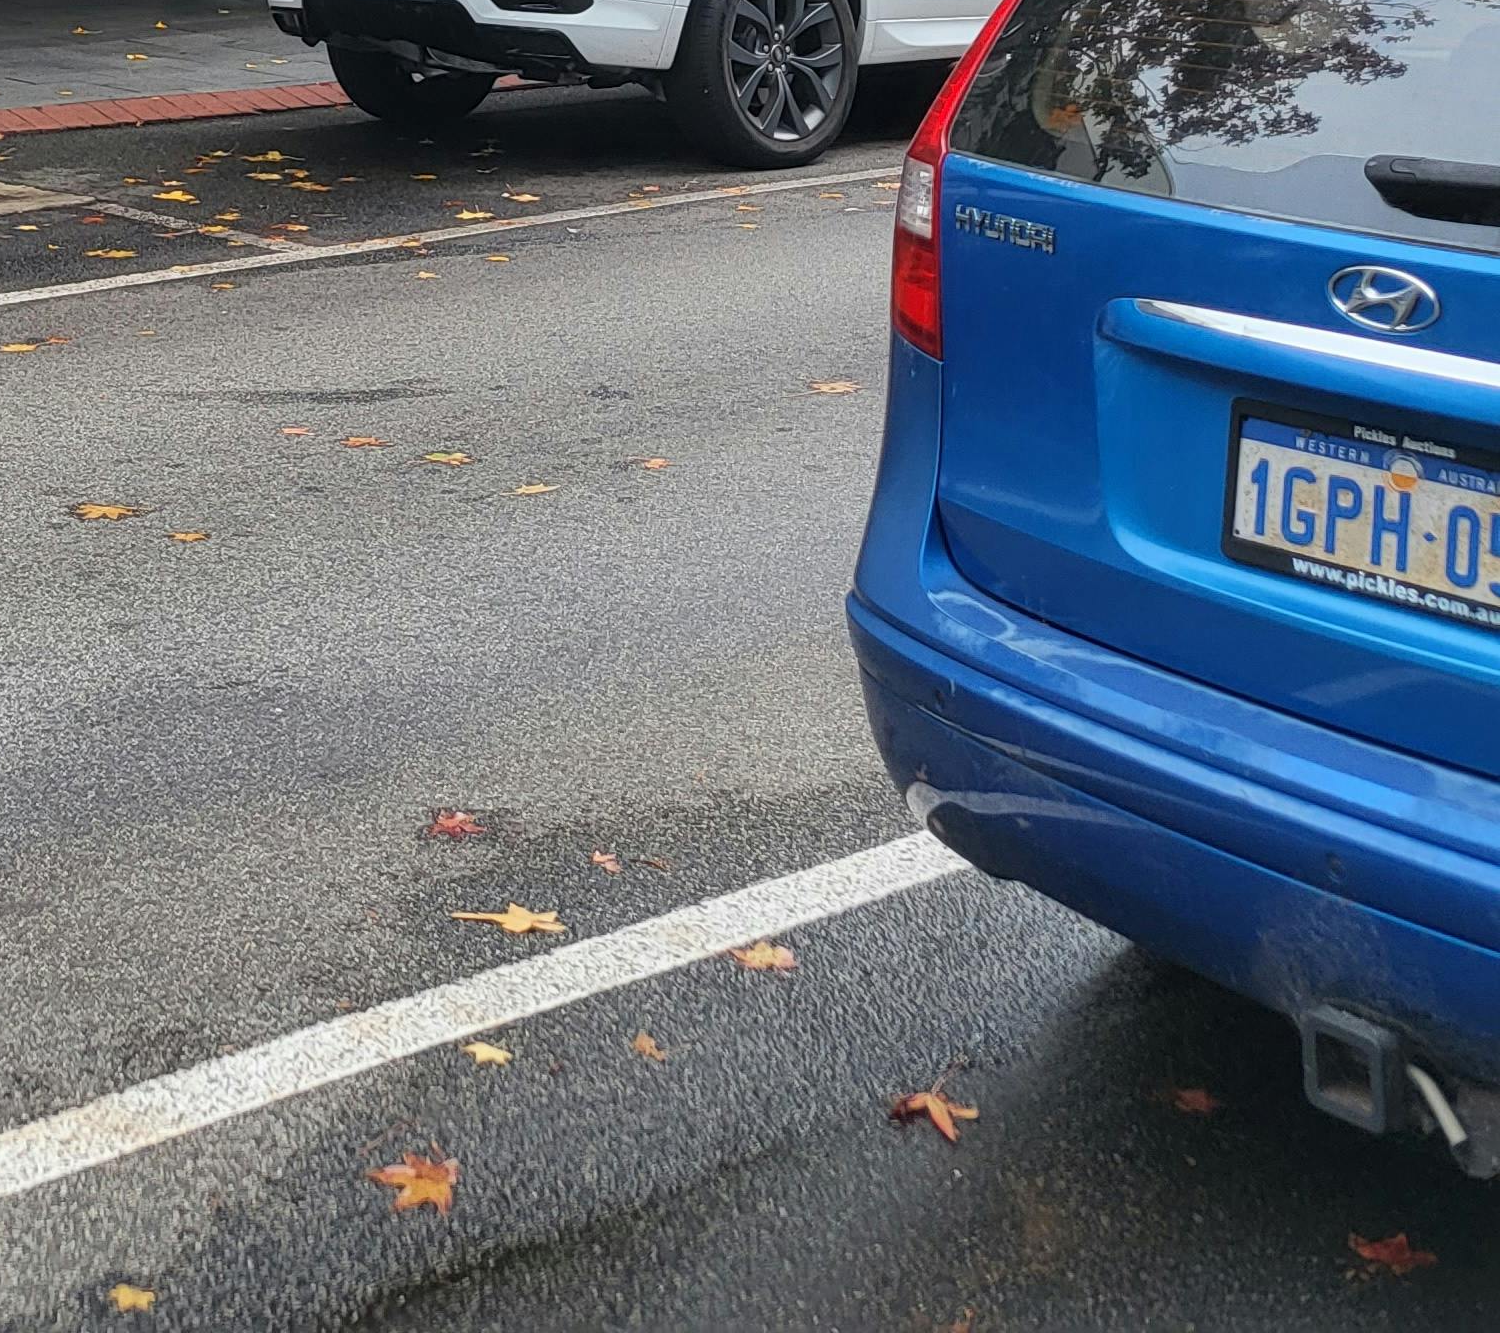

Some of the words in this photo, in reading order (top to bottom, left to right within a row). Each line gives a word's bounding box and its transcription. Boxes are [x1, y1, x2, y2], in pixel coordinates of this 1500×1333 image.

[955, 204, 1056, 255] HYUNDAI
[1295, 436, 1370, 464] WESTERN
[1437, 468, 1500, 495] AUSTRA
[1353, 424, 1397, 447] Pickles
[1402, 435, 1457, 459] Auctions
